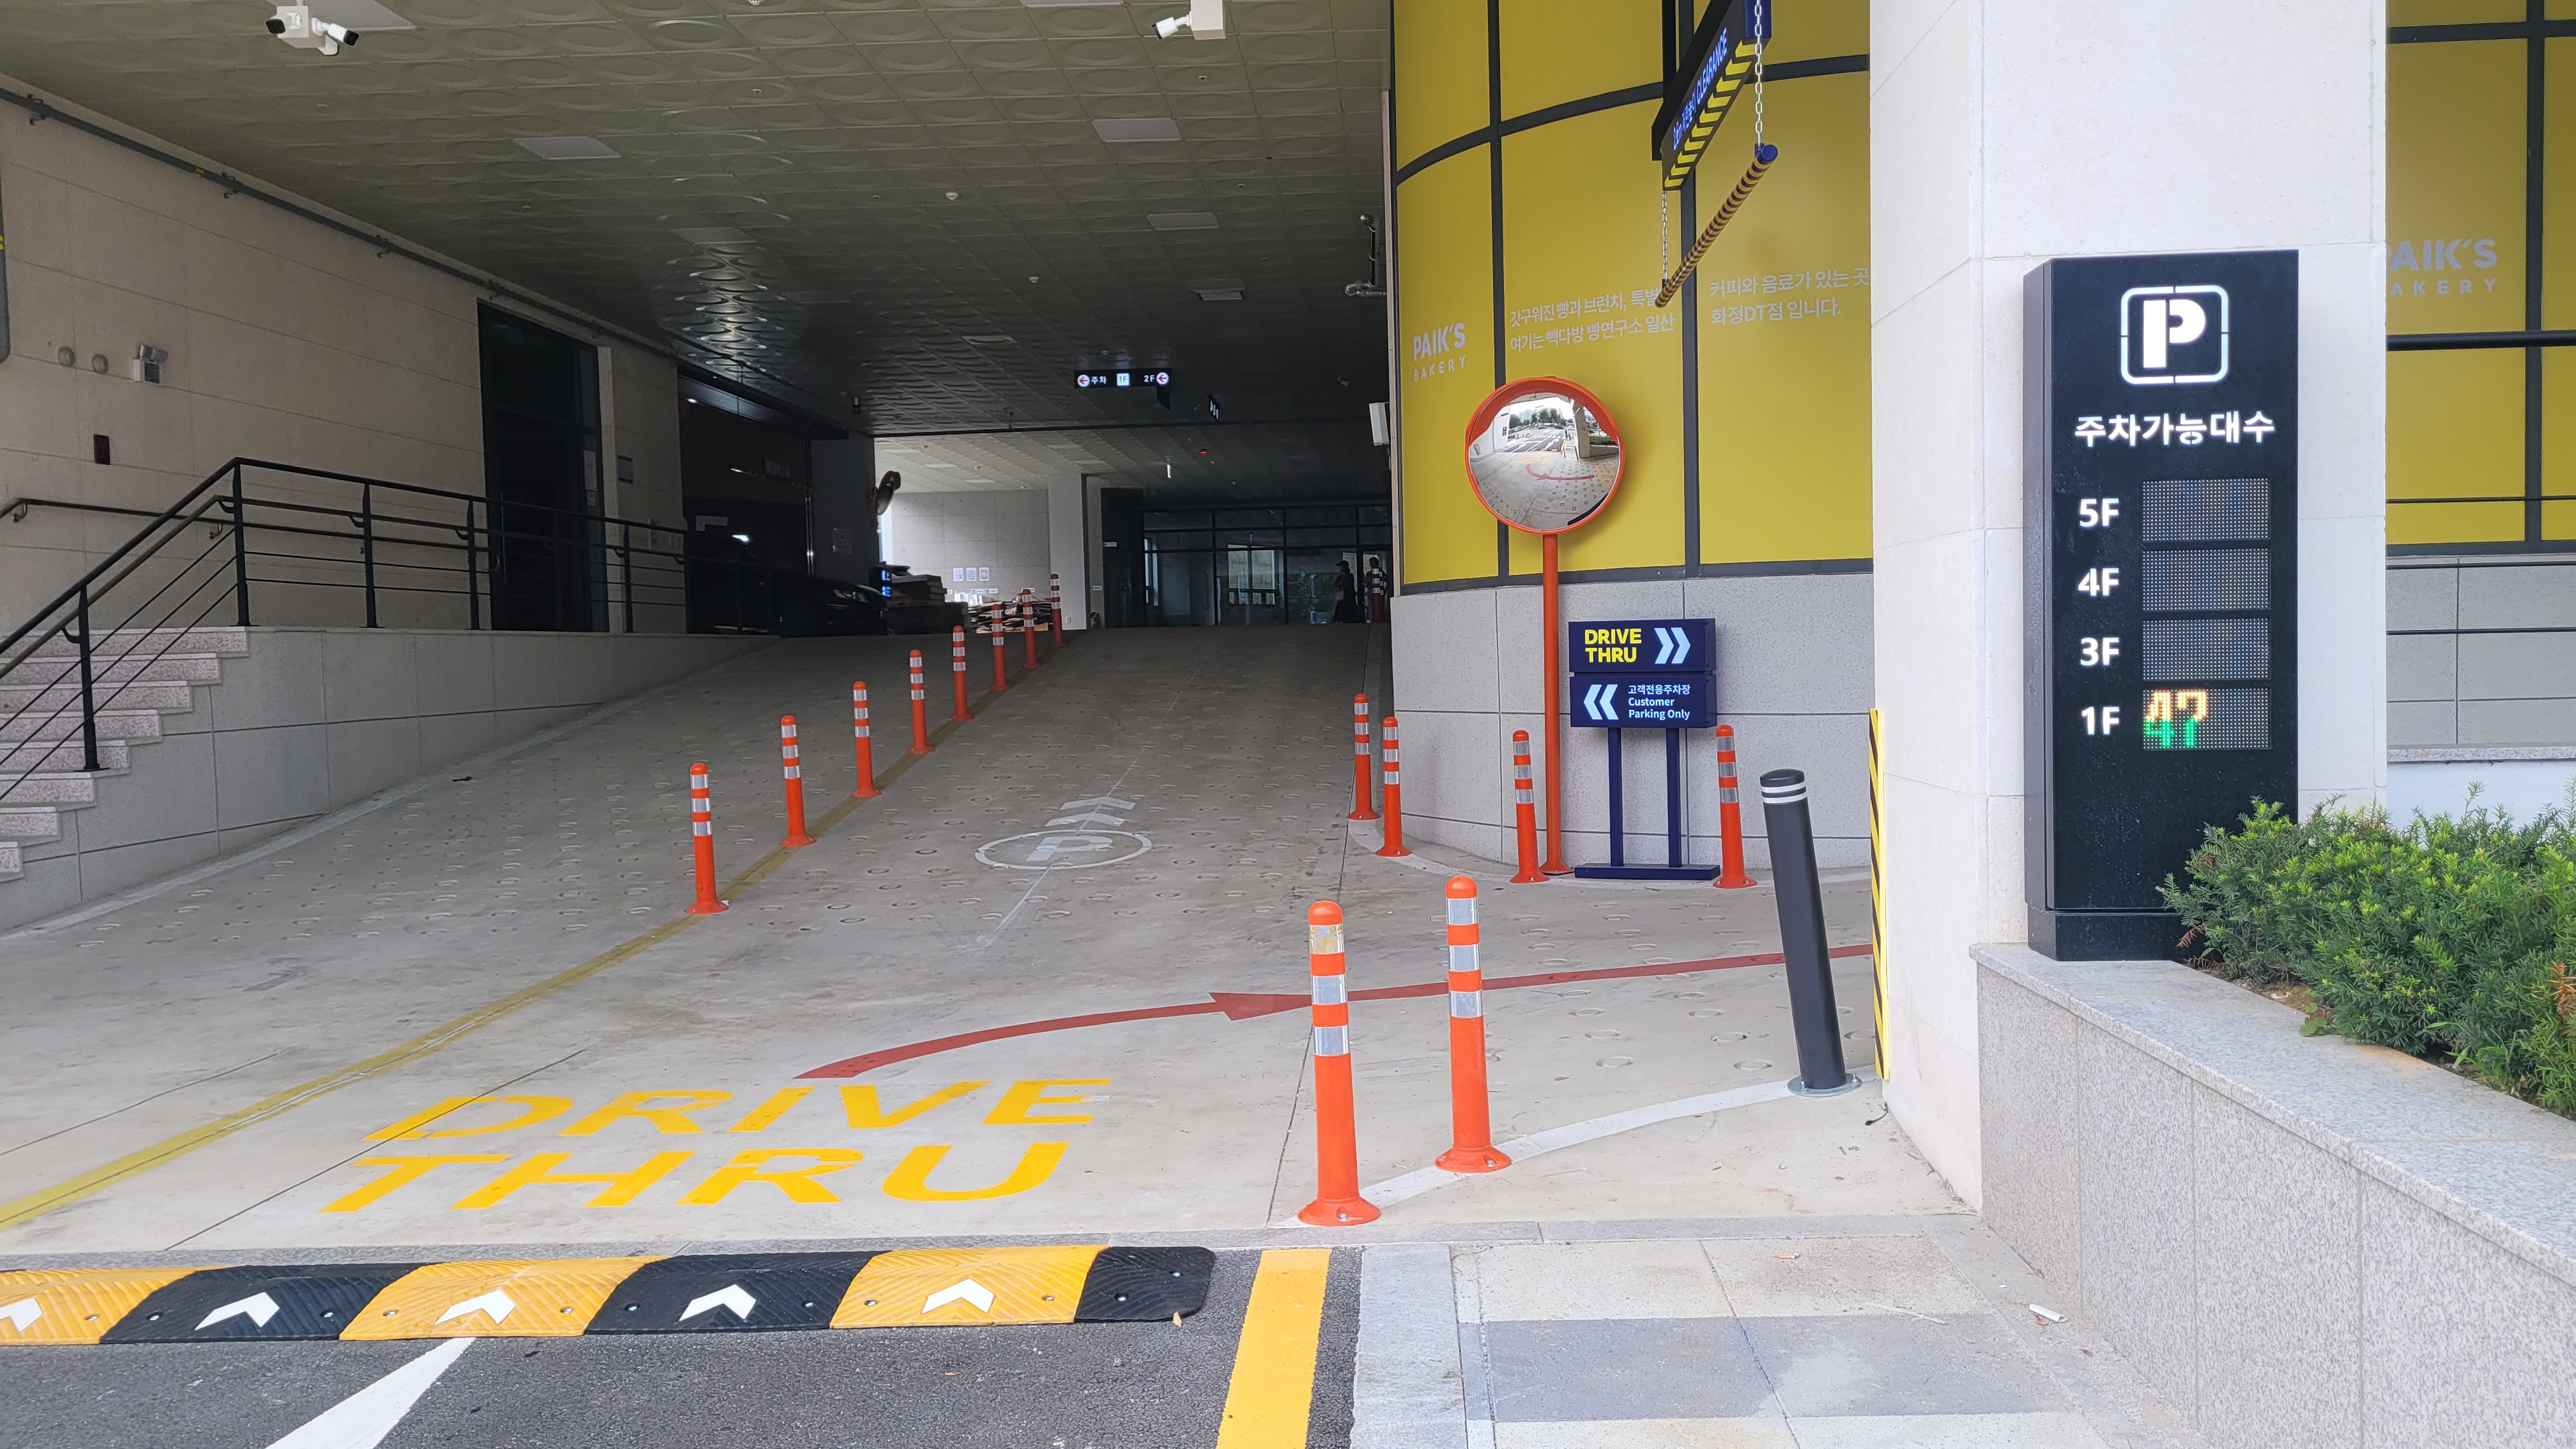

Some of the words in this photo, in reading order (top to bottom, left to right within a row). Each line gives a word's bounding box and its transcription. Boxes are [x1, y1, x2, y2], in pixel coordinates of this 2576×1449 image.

[1696, 27, 1728, 105] CLEARANCE
[2387, 238, 2497, 272] AIK'S
[1710, 276, 1758, 298] 커피와
[1761, 271, 1812, 294] 음료가
[1815, 269, 1849, 289] 있는
[1853, 267, 1870, 287] 곳
[2390, 278, 2496, 296] AKERY
[1510, 303, 1554, 328] 갓구워진
[1556, 298, 1582, 319] 빵과
[1584, 292, 1627, 314] 브런치,
[1630, 287, 1673, 308] 특별
[1711, 301, 1783, 325] 화정DT점
[1787, 296, 1842, 319] 입니다.
[1413, 322, 1466, 362] PAIK'S
[1510, 333, 1544, 352] 여기는
[1545, 325, 1584, 346] 빽다방
[1586, 317, 1644, 341] 빵연구소
[1646, 312, 1675, 334] 일산
[2143, 300, 2207, 369] P
[1091, 376, 1107, 384] 주차
[1144, 374, 1155, 383] 2F
[1414, 355, 1466, 381] BAKERY
[2074, 411, 2276, 447] 주차가능대수
[2079, 498, 2120, 528] 5F
[2078, 567, 2120, 597] 4F
[1584, 628, 1642, 645] DRIVE
[2080, 637, 2120, 666] 3F
[1585, 647, 1637, 663] THRU
[1628, 684, 1691, 695] 고객전용주차장
[1629, 697, 1675, 707] Customer
[1629, 709, 1666, 721] Parking
[1667, 709, 1690, 721] Only
[2082, 706, 2120, 735] 1F
[2143, 689, 2208, 748] 47
[360, 1078, 1113, 1141] DRIVE
[316, 1141, 1070, 1213] THRU
